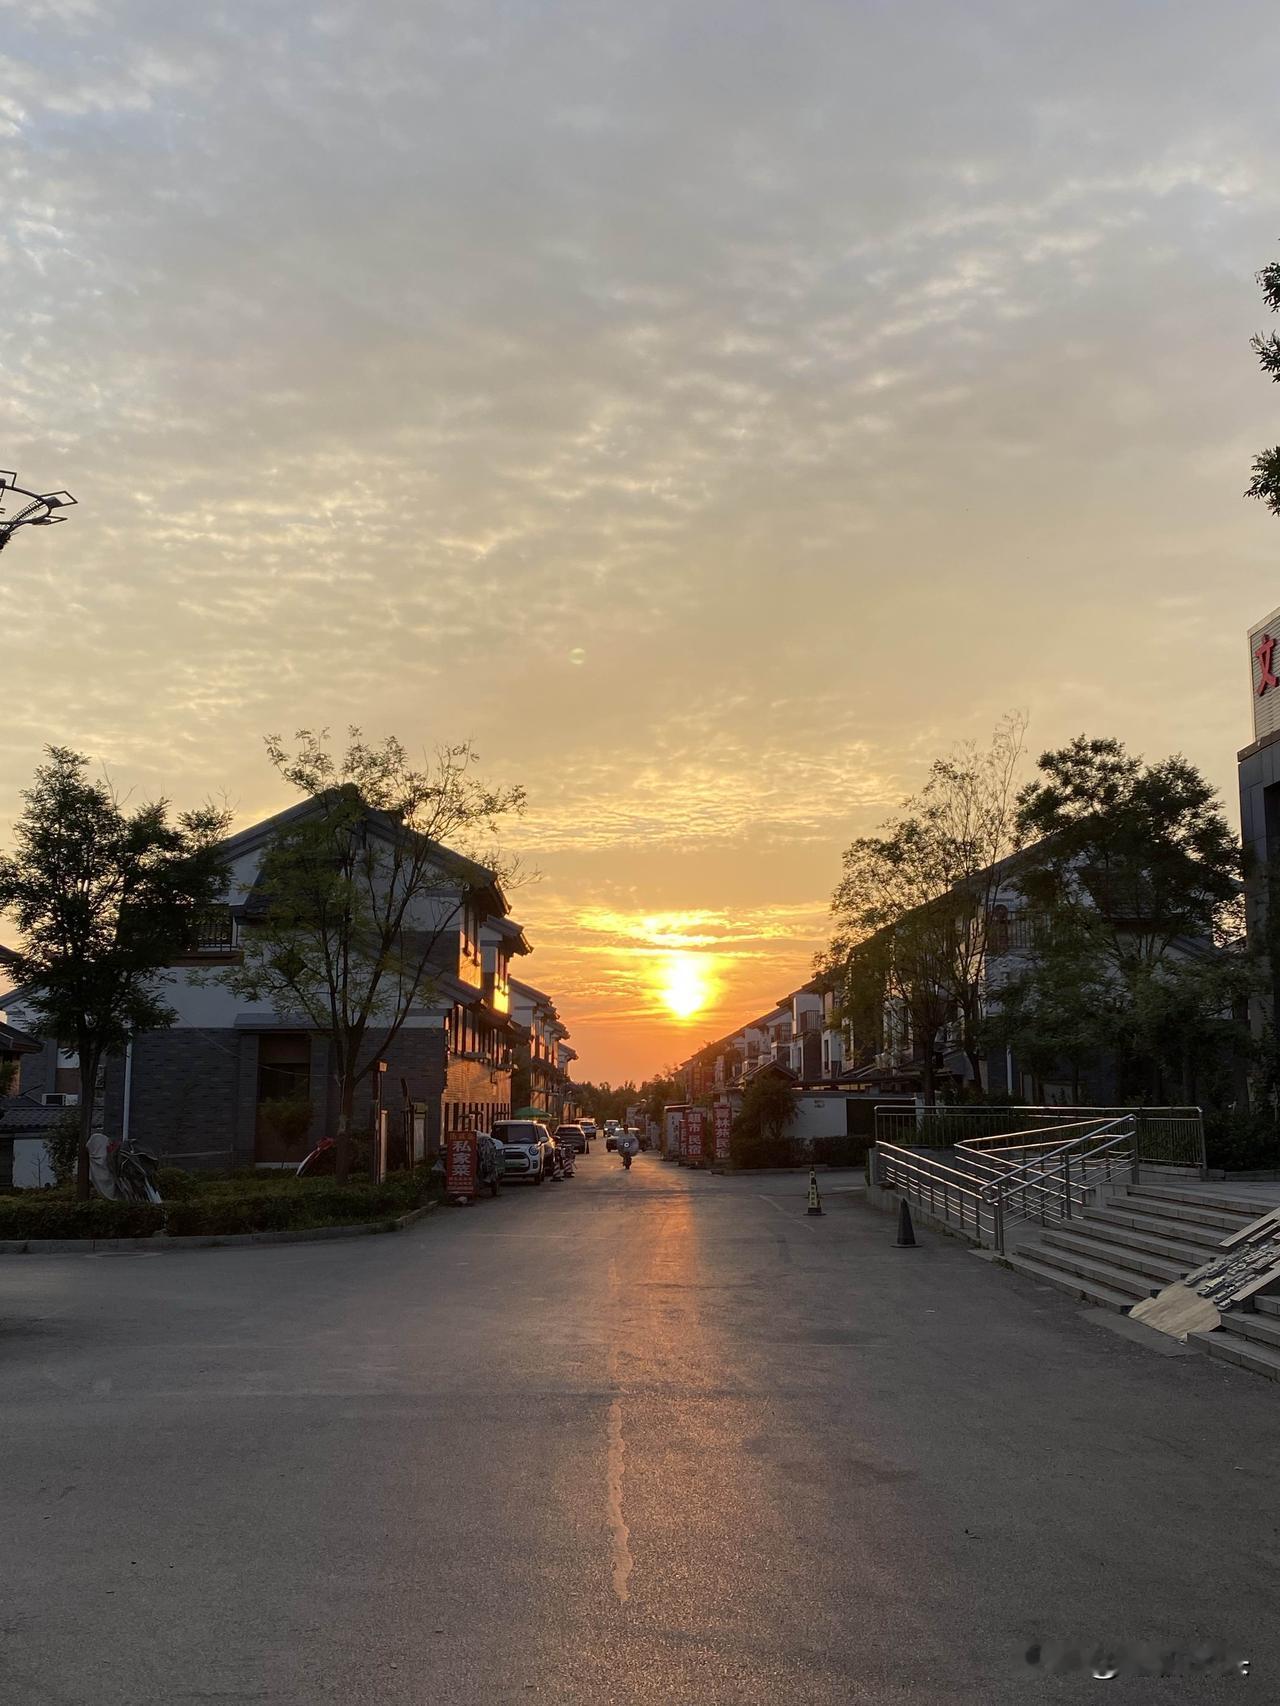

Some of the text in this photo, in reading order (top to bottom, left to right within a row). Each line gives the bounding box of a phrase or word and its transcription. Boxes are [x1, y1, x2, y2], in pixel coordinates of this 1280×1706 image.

[1254, 633, 1277, 697] 文
[687, 1113, 702, 1154] 超市民宿
[451, 1140, 472, 1176] 私家菜
